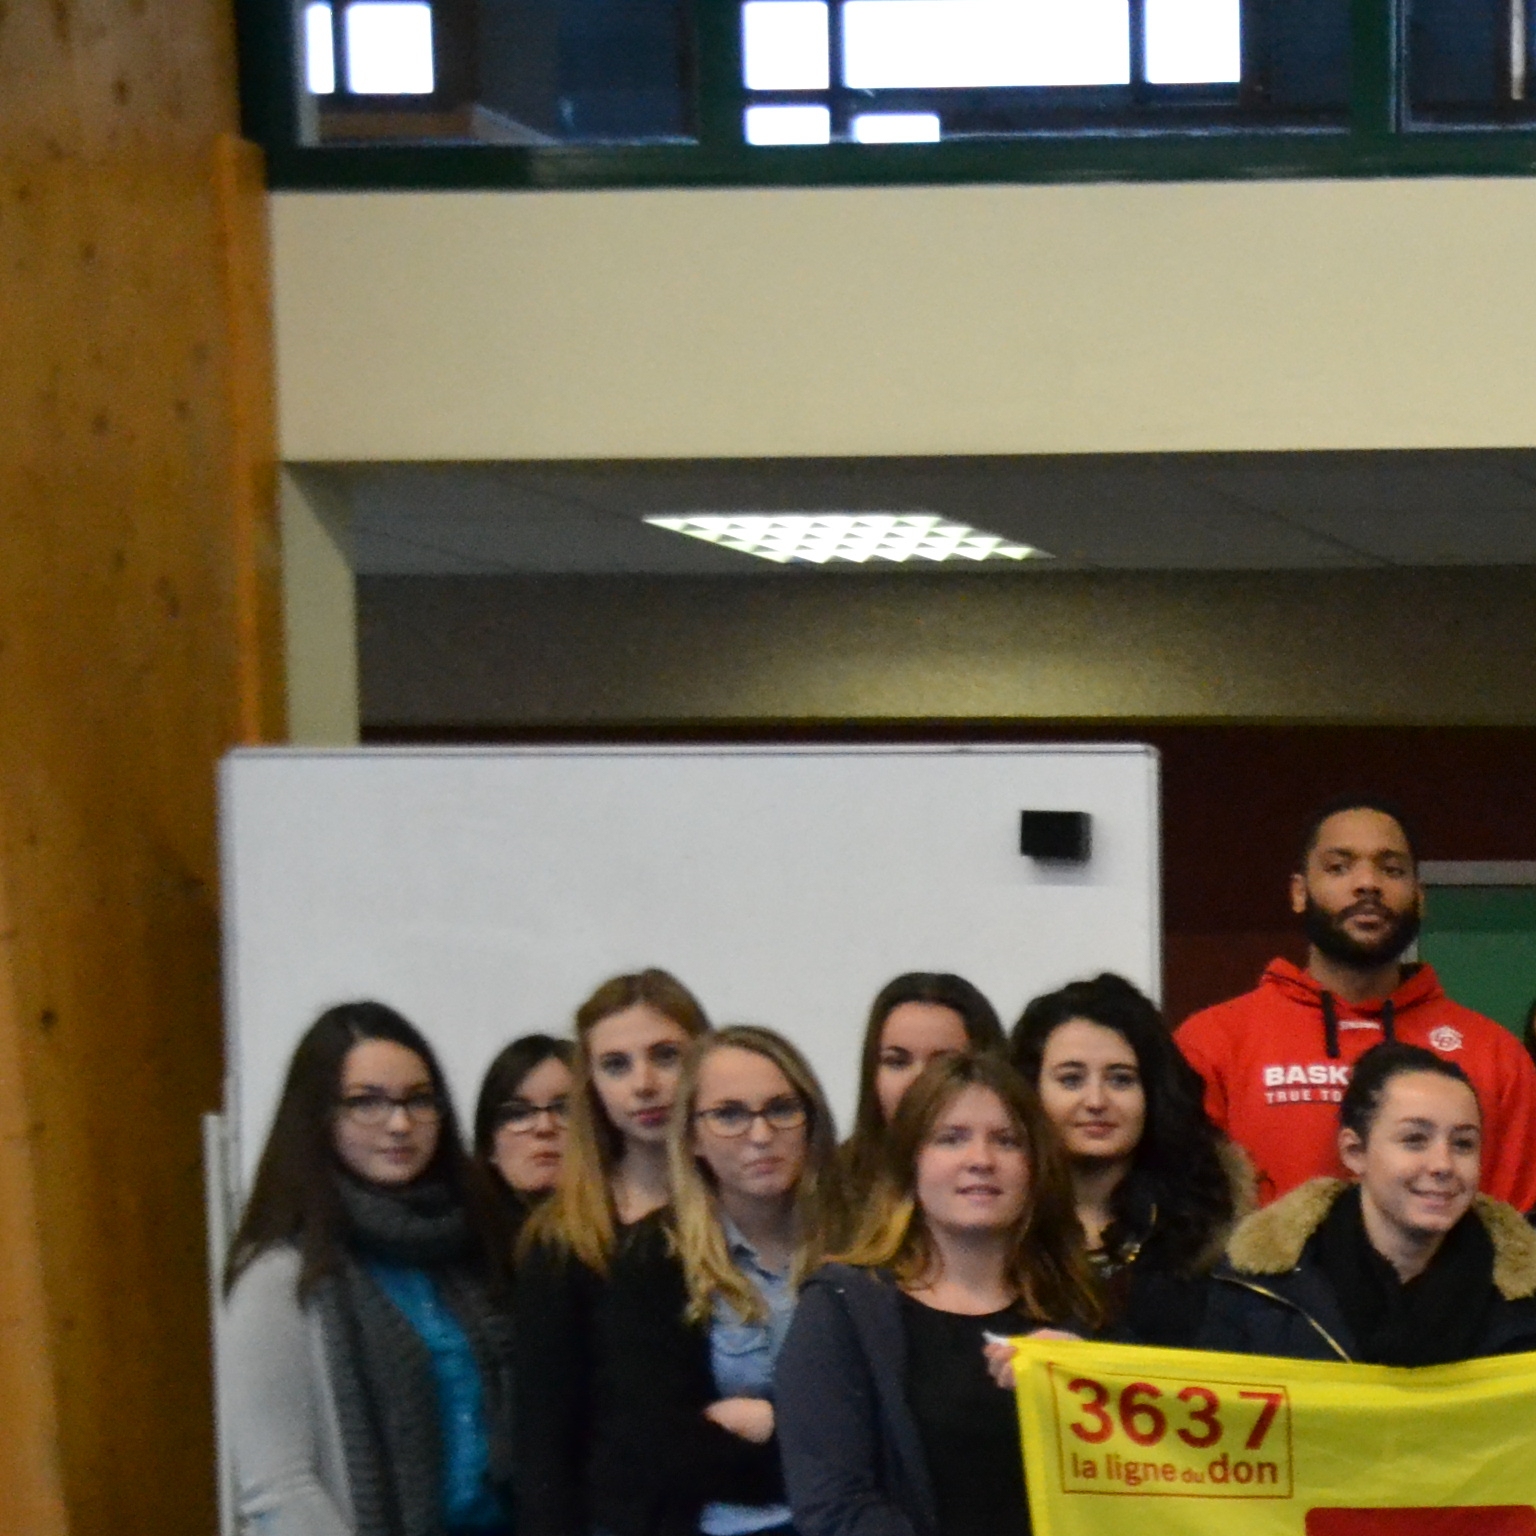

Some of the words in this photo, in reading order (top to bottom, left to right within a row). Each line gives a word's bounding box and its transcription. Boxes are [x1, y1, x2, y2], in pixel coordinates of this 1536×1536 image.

[1264, 1090, 1312, 1104] TRUE
[1321, 1089, 1342, 1102] TO
[1067, 1378, 1285, 1450] 3637
[1071, 1453, 1098, 1479] la
[1105, 1454, 1177, 1486] ligne
[1181, 1468, 1204, 1484] du
[1208, 1453, 1279, 1484] don
